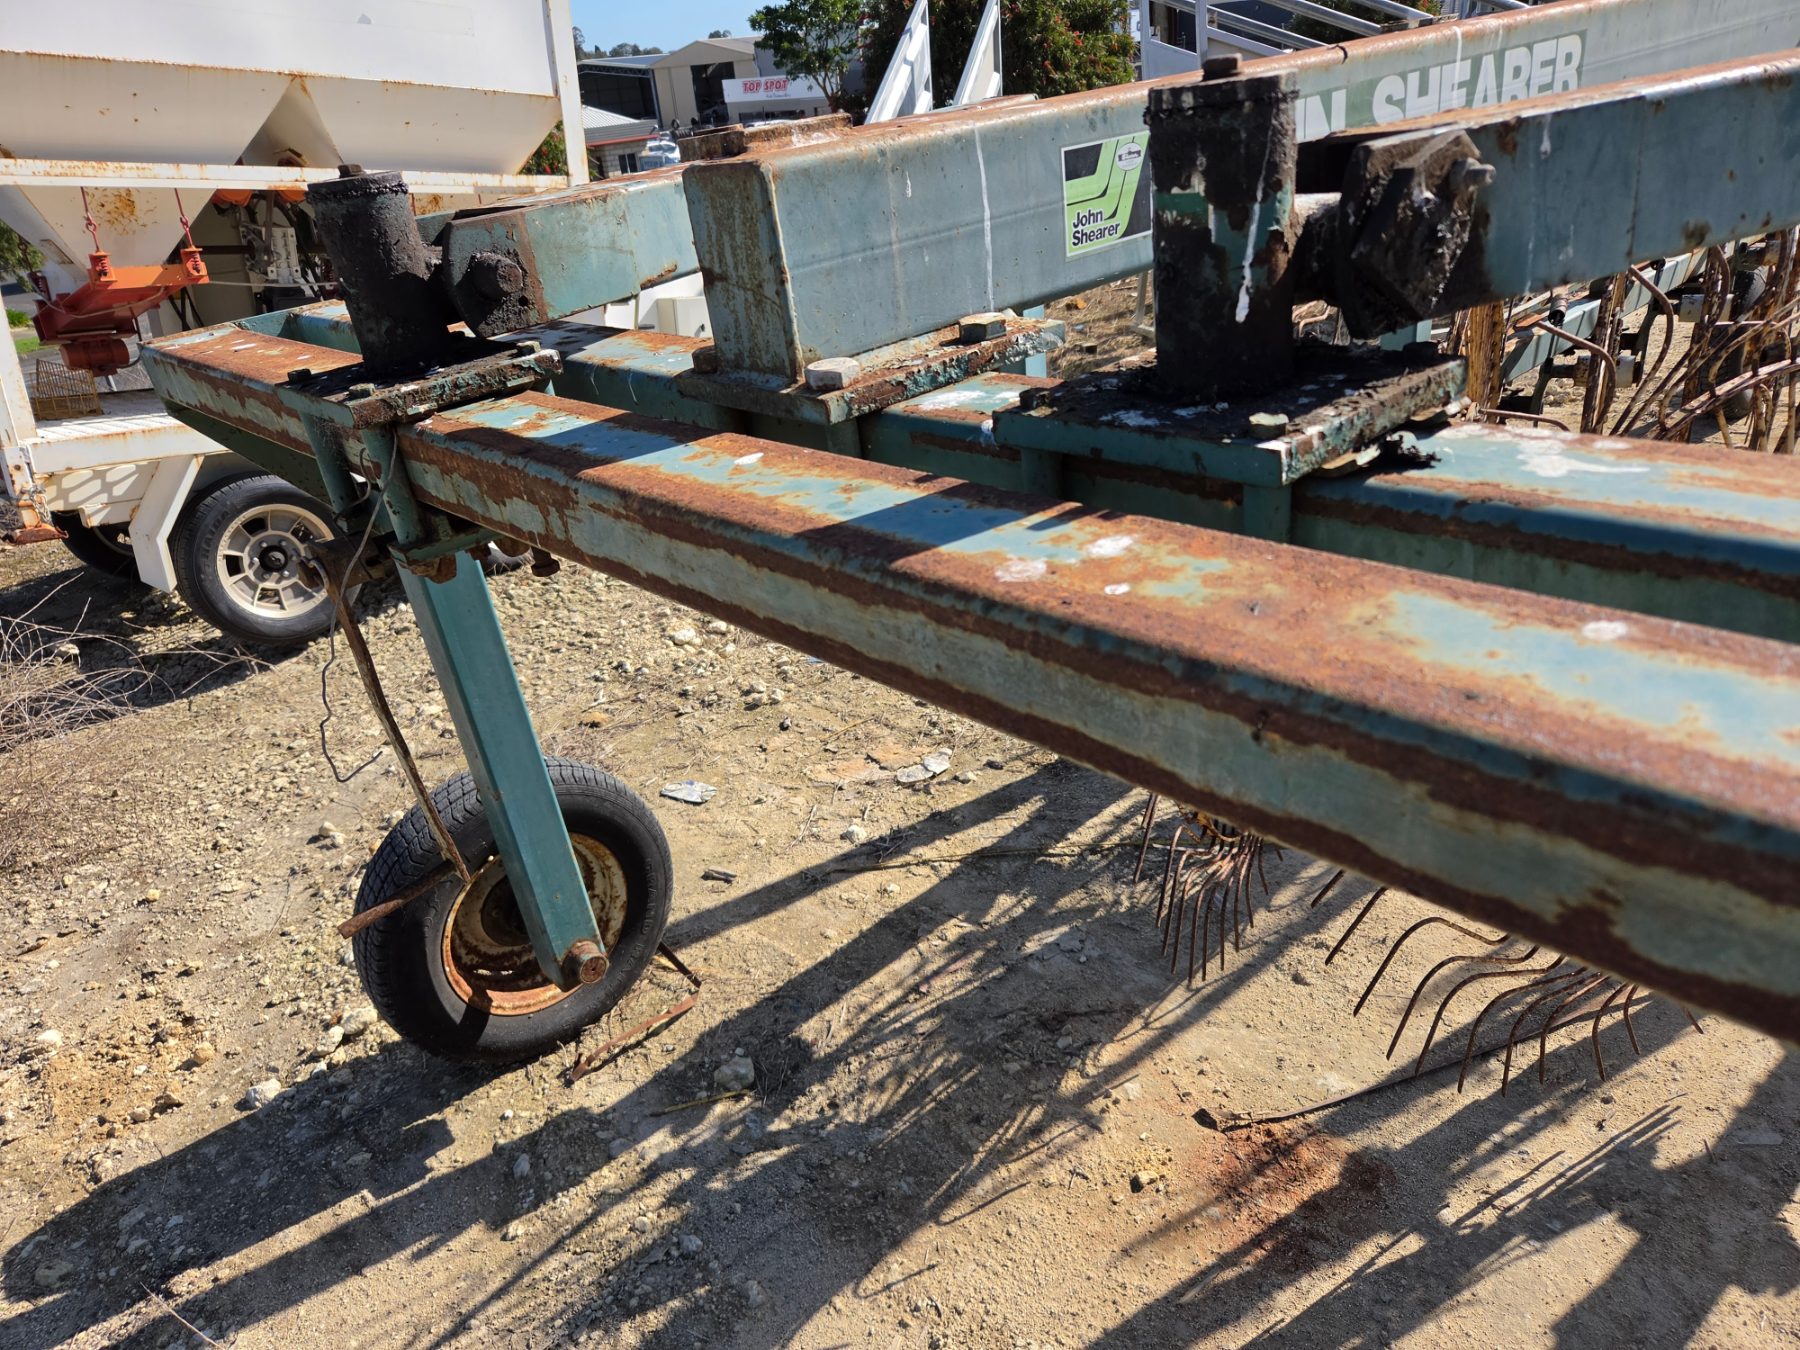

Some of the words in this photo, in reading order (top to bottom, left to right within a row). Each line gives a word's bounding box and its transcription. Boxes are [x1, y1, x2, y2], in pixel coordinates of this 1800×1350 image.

[742, 81, 761, 93] TOP
[764, 79, 788, 92] SPOT
[1372, 34, 1582, 125] SHEARER
[1073, 209, 1103, 229] John
[1072, 222, 1121, 247] Shearer
